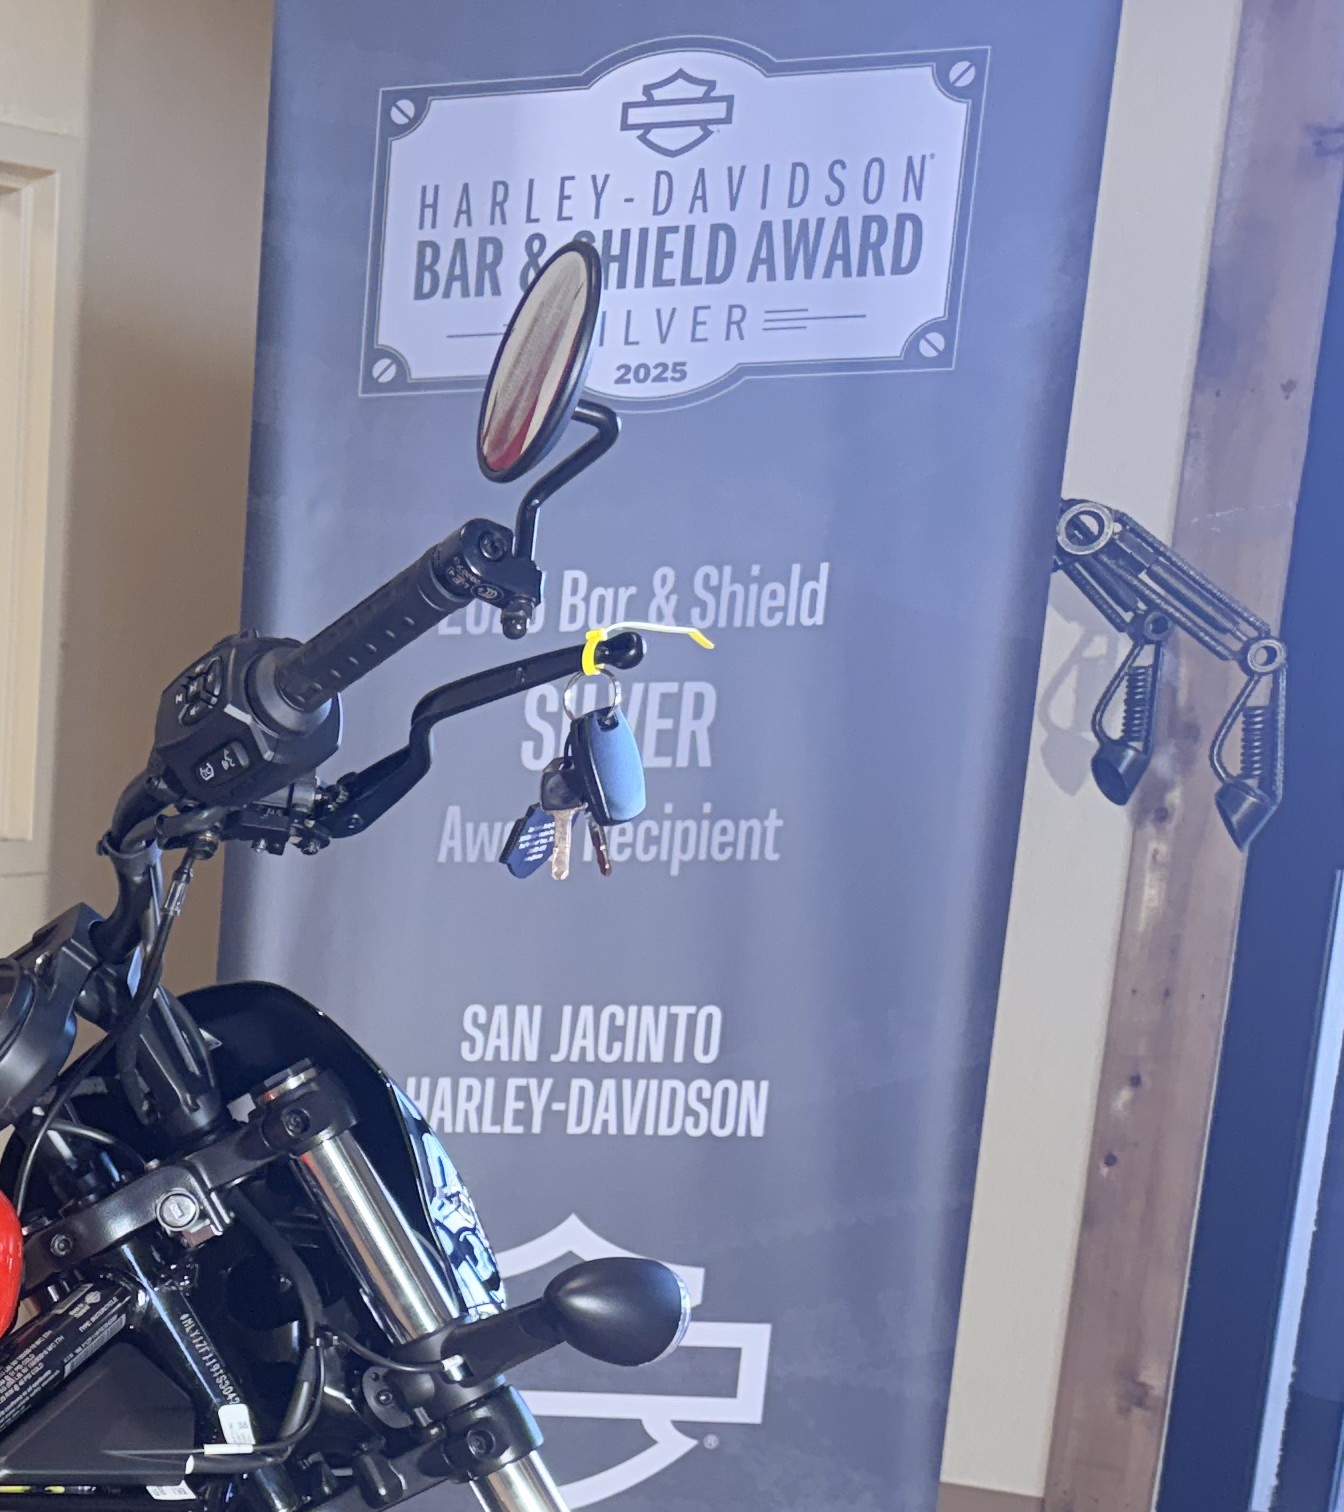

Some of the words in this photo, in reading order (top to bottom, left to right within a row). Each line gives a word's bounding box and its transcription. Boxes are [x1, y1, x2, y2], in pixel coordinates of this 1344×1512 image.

[418, 153, 927, 231] HARLEY-DAVIDSON
[414, 235, 503, 301] BAR
[572, 222, 737, 290] HIELD
[747, 212, 924, 283] AWARD
[598, 303, 748, 348] ILVER
[614, 360, 689, 386] 2025
[559, 569, 638, 633] Bar
[648, 565, 678, 630] &
[691, 561, 830, 629] Shield
[520, 680, 718, 772] SIVER
[460, 1004, 542, 1062] SAN
[549, 1004, 723, 1064] JACINTO
[405, 1076, 769, 1138] HARLEY-DAVIDSON
